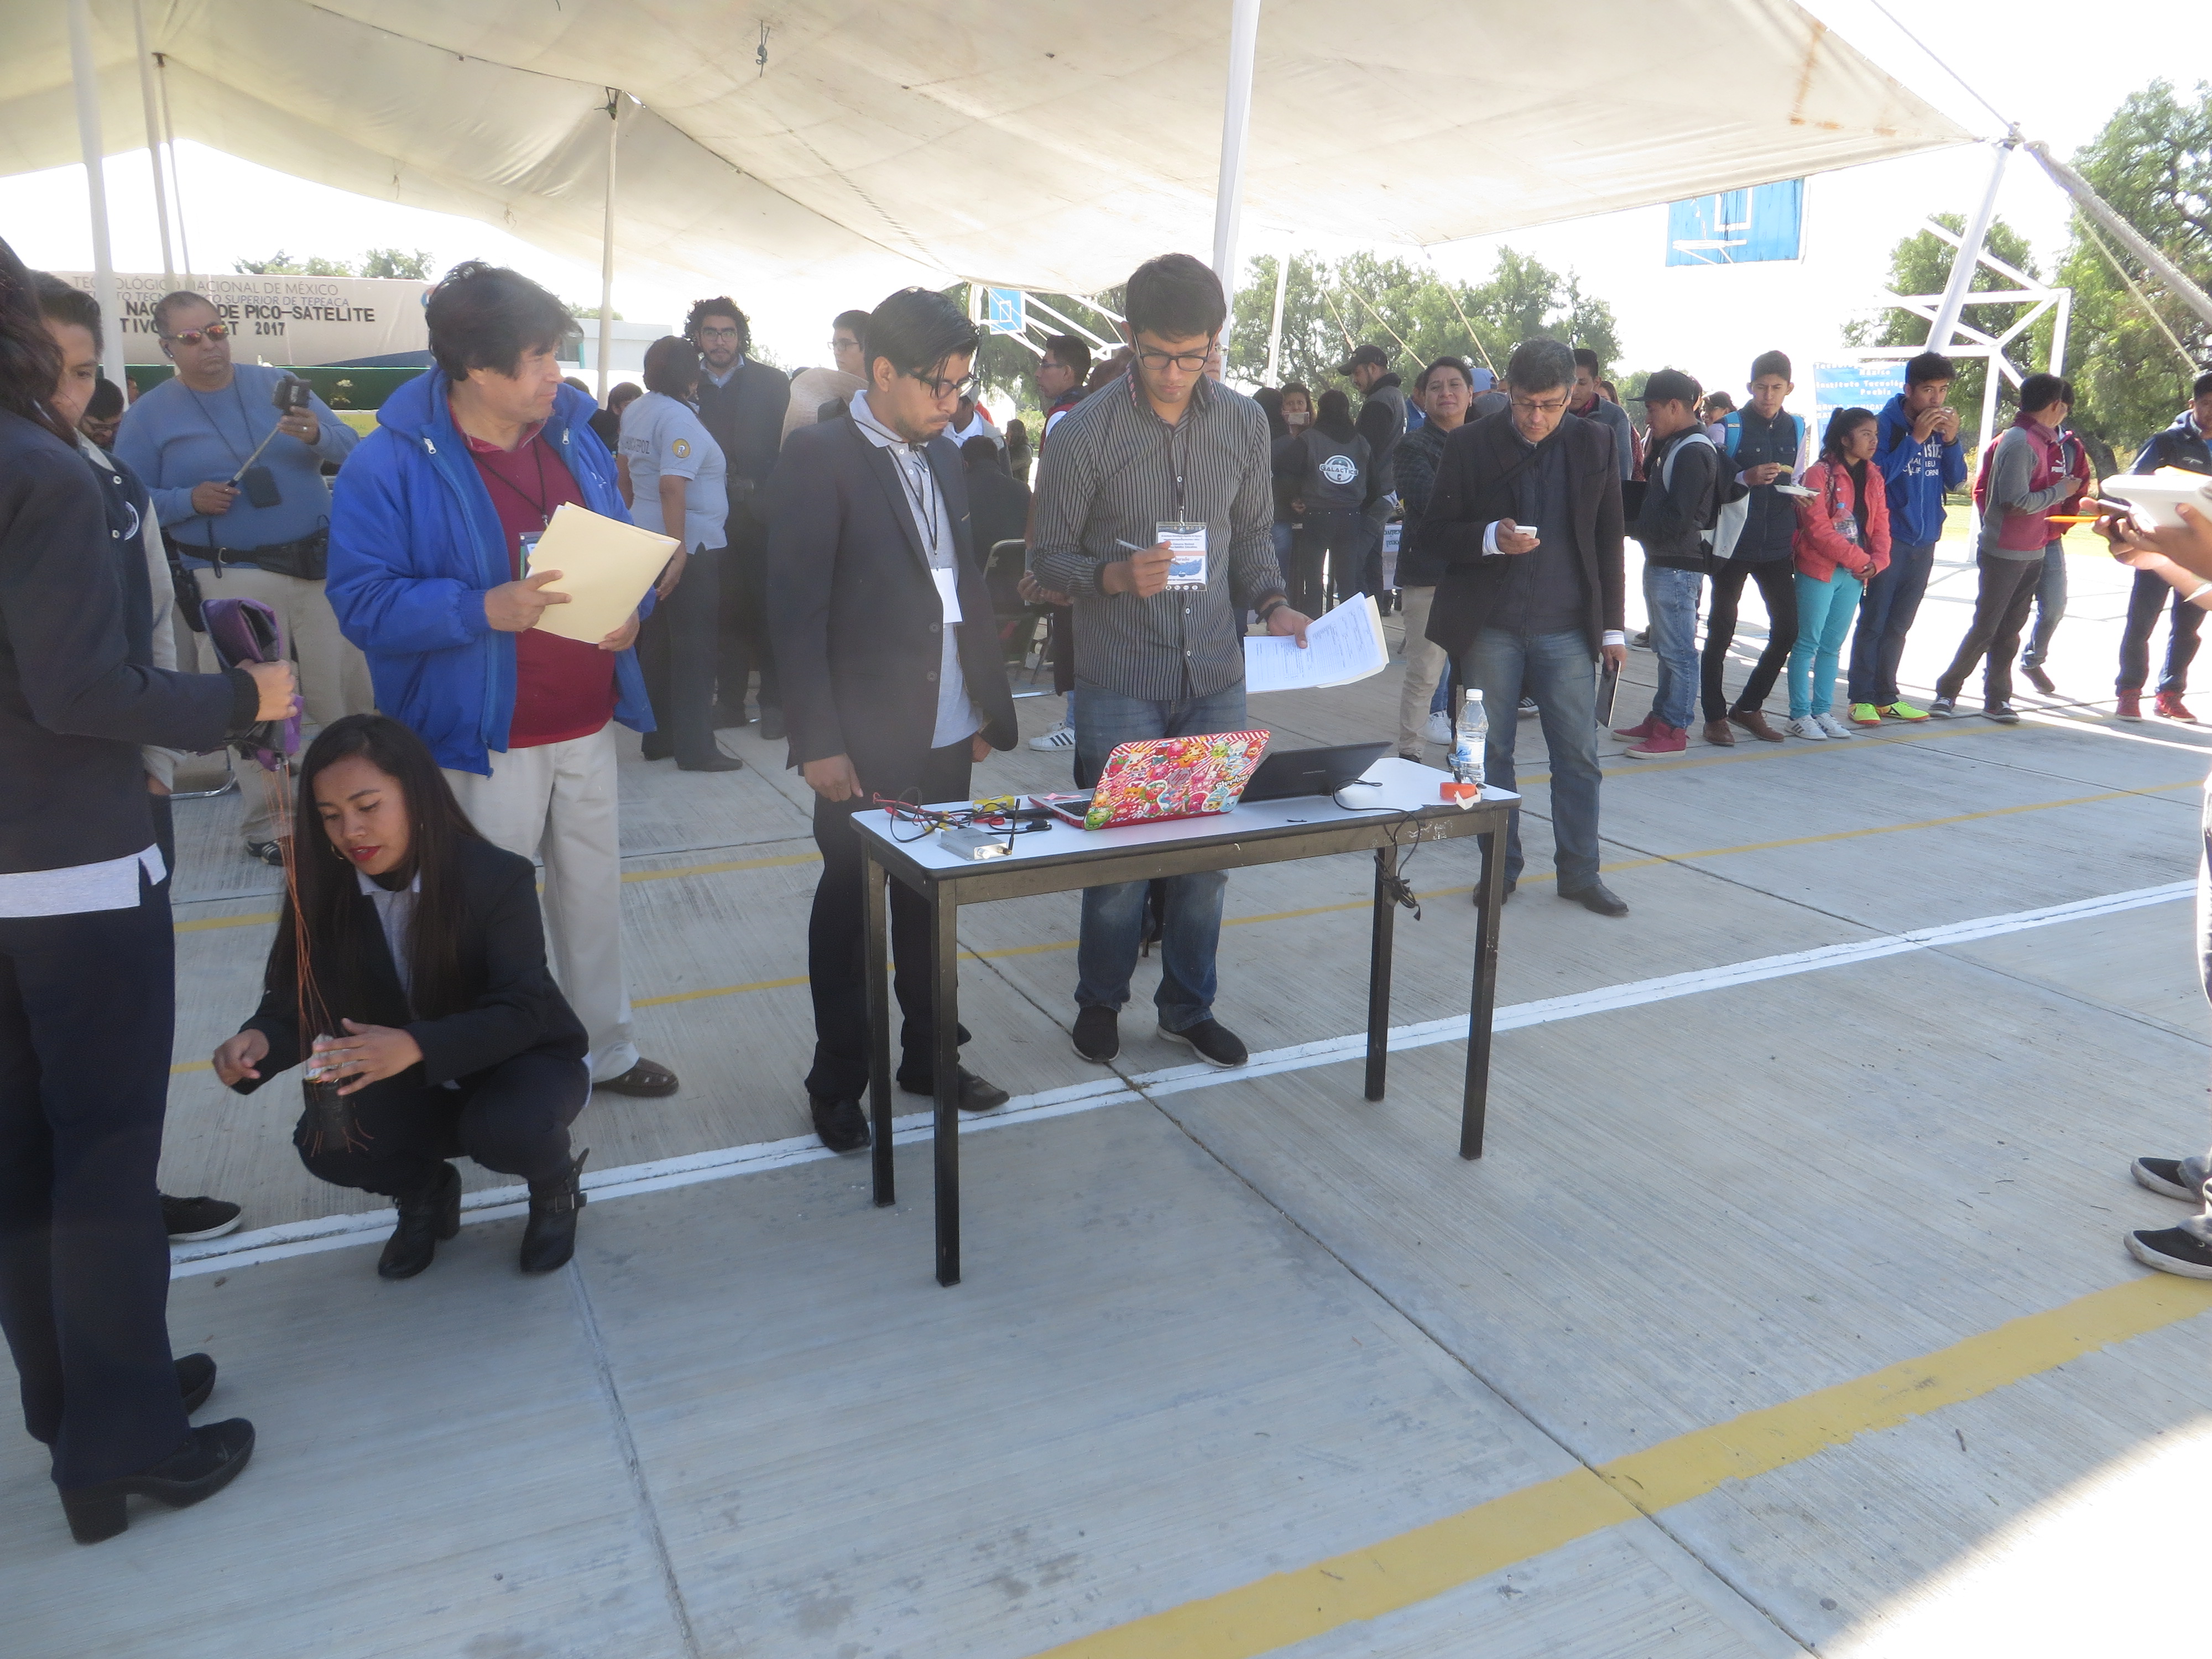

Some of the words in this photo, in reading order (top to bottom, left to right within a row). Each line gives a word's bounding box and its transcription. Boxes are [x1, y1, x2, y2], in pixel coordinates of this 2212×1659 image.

[72, 276, 181, 290] TECOLÓGIC
[264, 283, 281, 294] DE
[286, 281, 338, 296] MÉXICO
[225, 295, 279, 305] SUPERIOR
[283, 296, 297, 305] DE
[301, 297, 349, 306] TEPEACA
[217, 304, 240, 319] DE
[255, 321, 285, 336] 2017
[1172, 770, 1188, 785] hp
[1215, 774, 1249, 789] Shopkins
